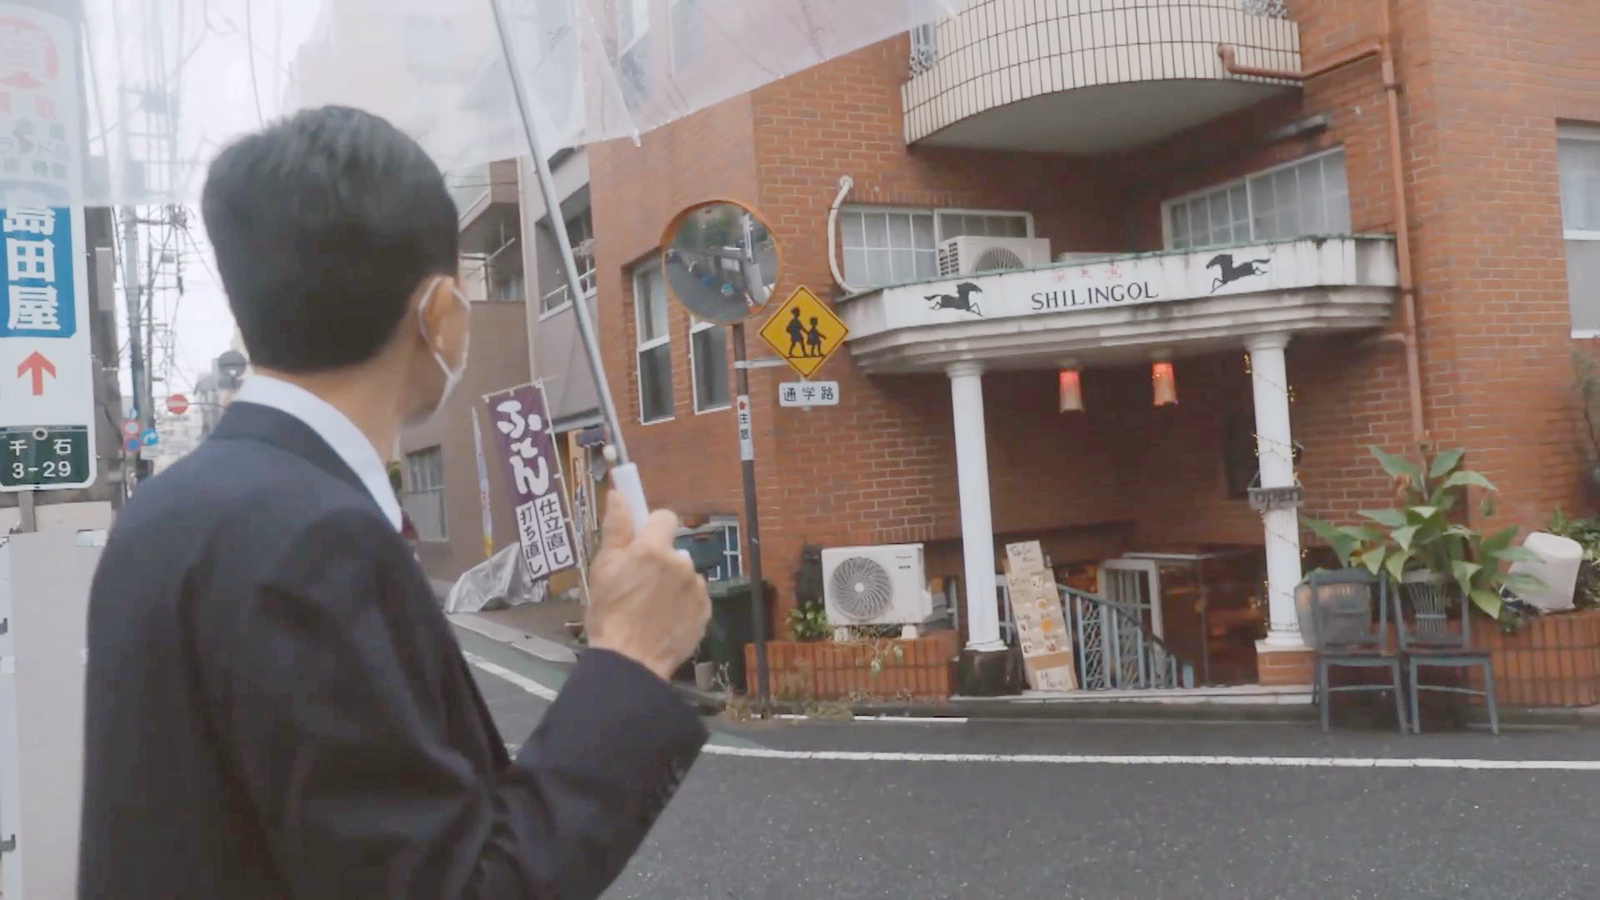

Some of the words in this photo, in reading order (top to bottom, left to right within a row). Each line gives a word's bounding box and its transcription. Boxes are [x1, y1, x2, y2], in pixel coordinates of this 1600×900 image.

[3, 188, 61, 331] 島田屋
[1031, 281, 1159, 311] SHILINGOL
[783, 385, 834, 402] 通学路
[9, 438, 72, 456] 千石
[12, 460, 72, 479] 3-29
[496, 399, 550, 496] ふとん
[519, 507, 544, 575] 打ち直し
[539, 497, 570, 565] 仕立直し
